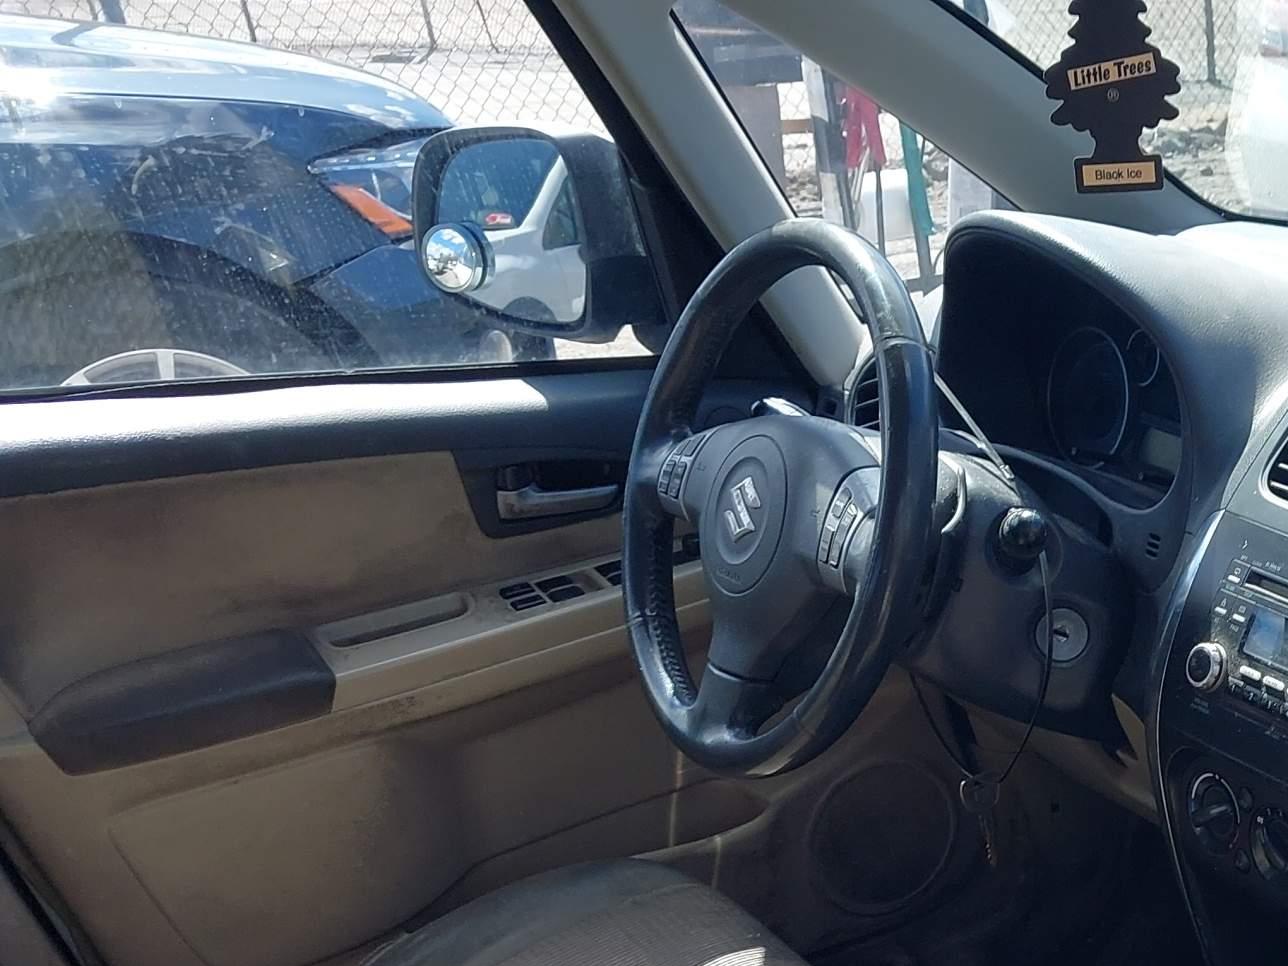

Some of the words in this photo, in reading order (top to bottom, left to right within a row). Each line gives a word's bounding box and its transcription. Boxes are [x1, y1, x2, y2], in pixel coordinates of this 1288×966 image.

[1073, 65, 1110, 87] Little
[1113, 59, 1151, 78] Trees
[1095, 168, 1123, 180] Black
[1127, 168, 1142, 179] Ice
